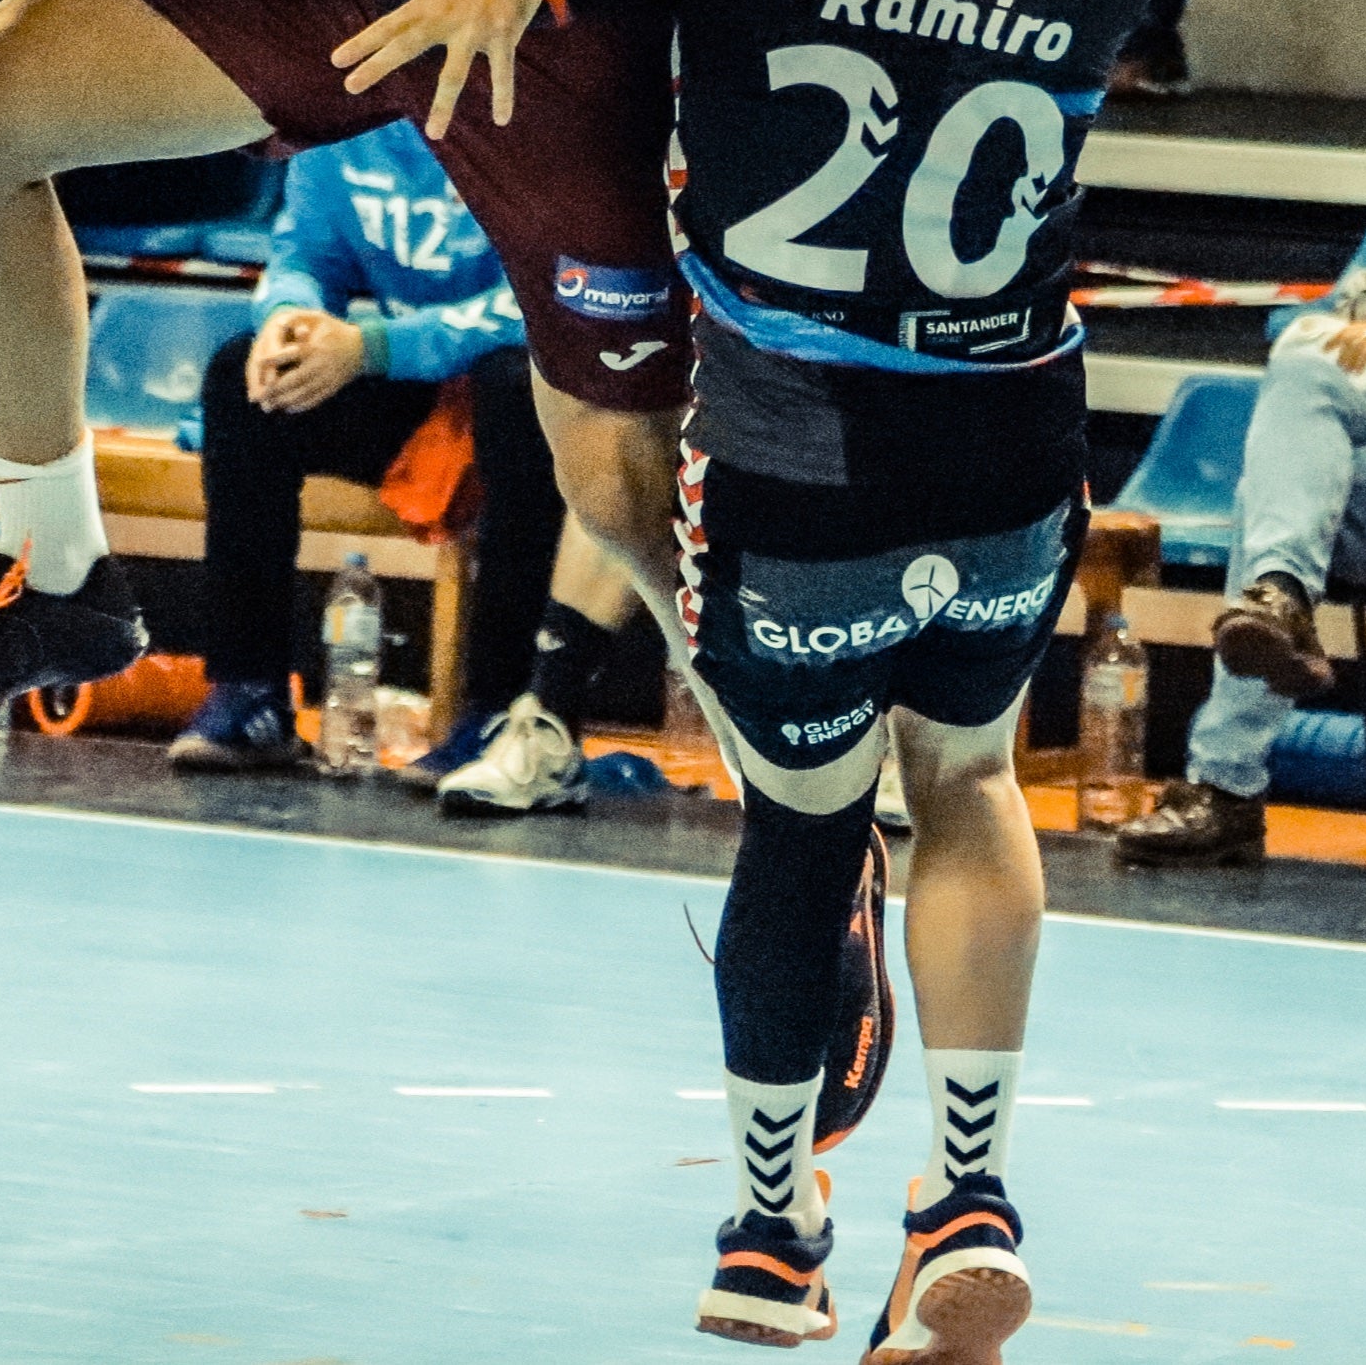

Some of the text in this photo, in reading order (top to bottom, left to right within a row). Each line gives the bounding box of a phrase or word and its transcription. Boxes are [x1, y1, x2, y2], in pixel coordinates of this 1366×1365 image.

[724, 44, 1065, 298] 20
[583, 286, 670, 310] mayoral
[926, 313, 1019, 335] SANTANDER
[944, 569, 1056, 622] ENERG
[843, 1015, 873, 1089] Kempa
